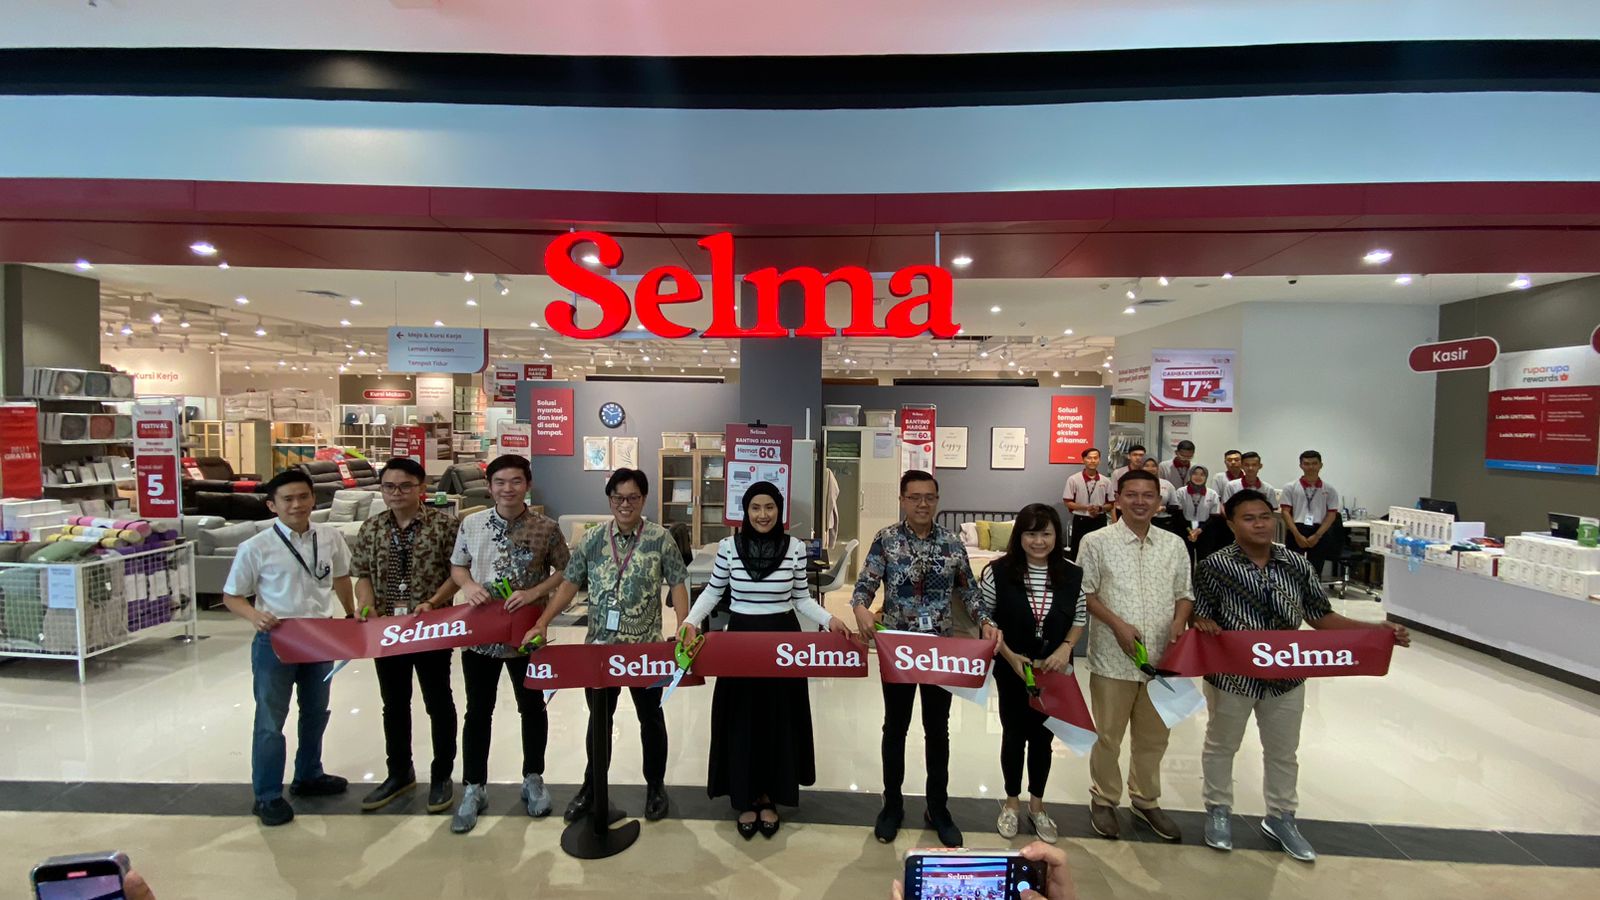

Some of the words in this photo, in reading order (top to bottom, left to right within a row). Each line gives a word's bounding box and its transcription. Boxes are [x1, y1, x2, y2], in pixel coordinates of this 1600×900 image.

[544, 231, 961, 339] Selma
[1432, 347, 1468, 363] Kasir
[157, 372, 179, 381] Kerja
[1523, 365, 1569, 375] ruparupa
[1523, 374, 1559, 383] rewards
[147, 474, 164, 496] 5
[380, 620, 468, 647] Selma
[608, 654, 693, 677] Selm
[776, 643, 861, 667] Selma
[894, 645, 986, 677] Selma
[1251, 642, 1354, 667] Selma
